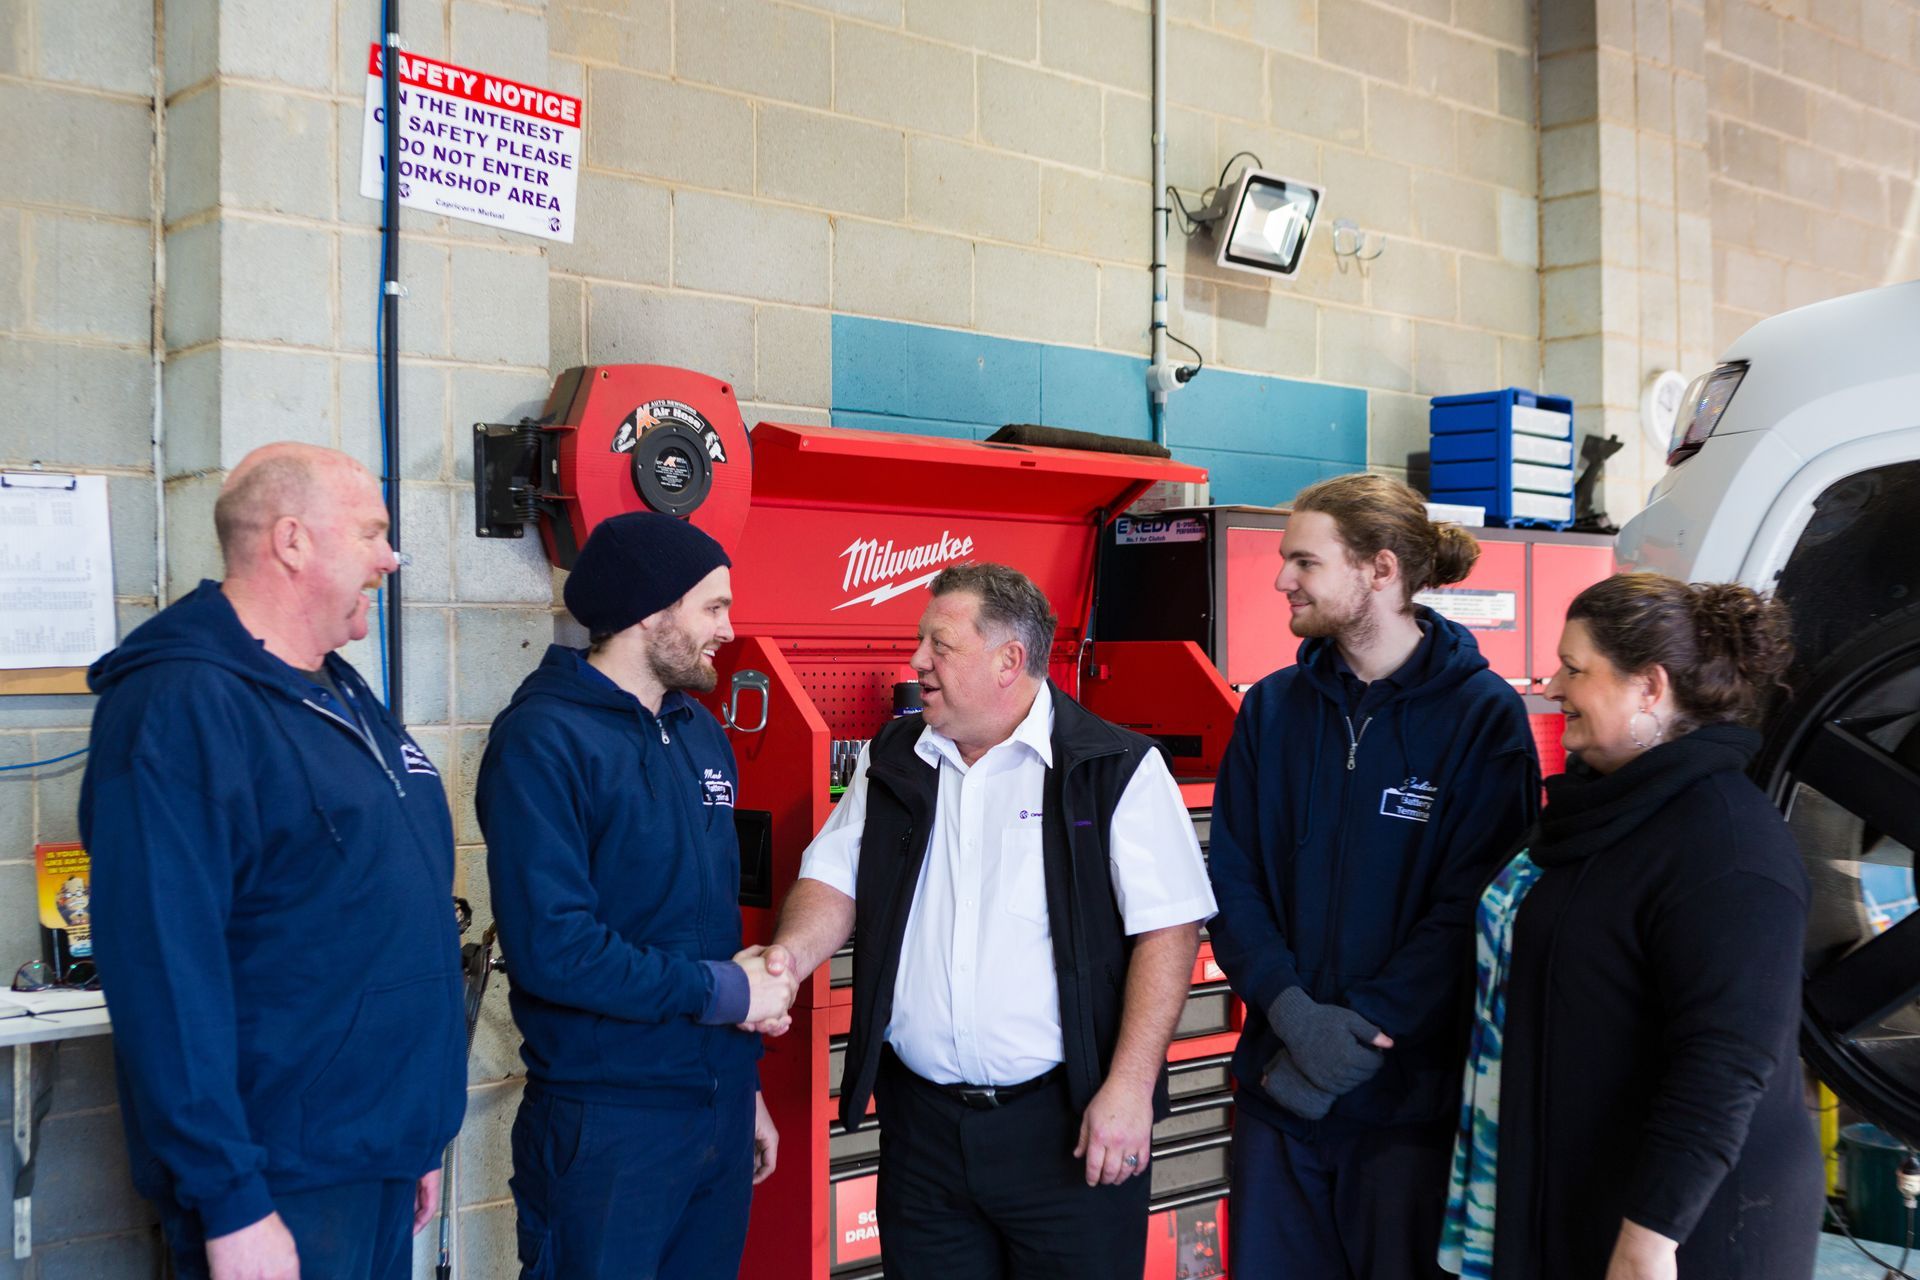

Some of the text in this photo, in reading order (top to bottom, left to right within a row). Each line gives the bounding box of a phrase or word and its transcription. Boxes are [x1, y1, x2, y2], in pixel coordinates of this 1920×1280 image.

[416, 93, 457, 119] THE
[464, 106, 565, 145] INTEREST
[484, 78, 577, 123] NOTICE
[409, 116, 489, 149] SAFETY
[497, 137, 573, 170] PLEASE
[433, 145, 476, 169] NOT
[483, 157, 549, 187] ENTER
[508, 187, 561, 213] AREA
[653, 407, 702, 430] Air Hose
[1117, 519, 1172, 535] EXEDY
[839, 530, 975, 593] Milwaukee
[845, 1225, 880, 1244] DRA
